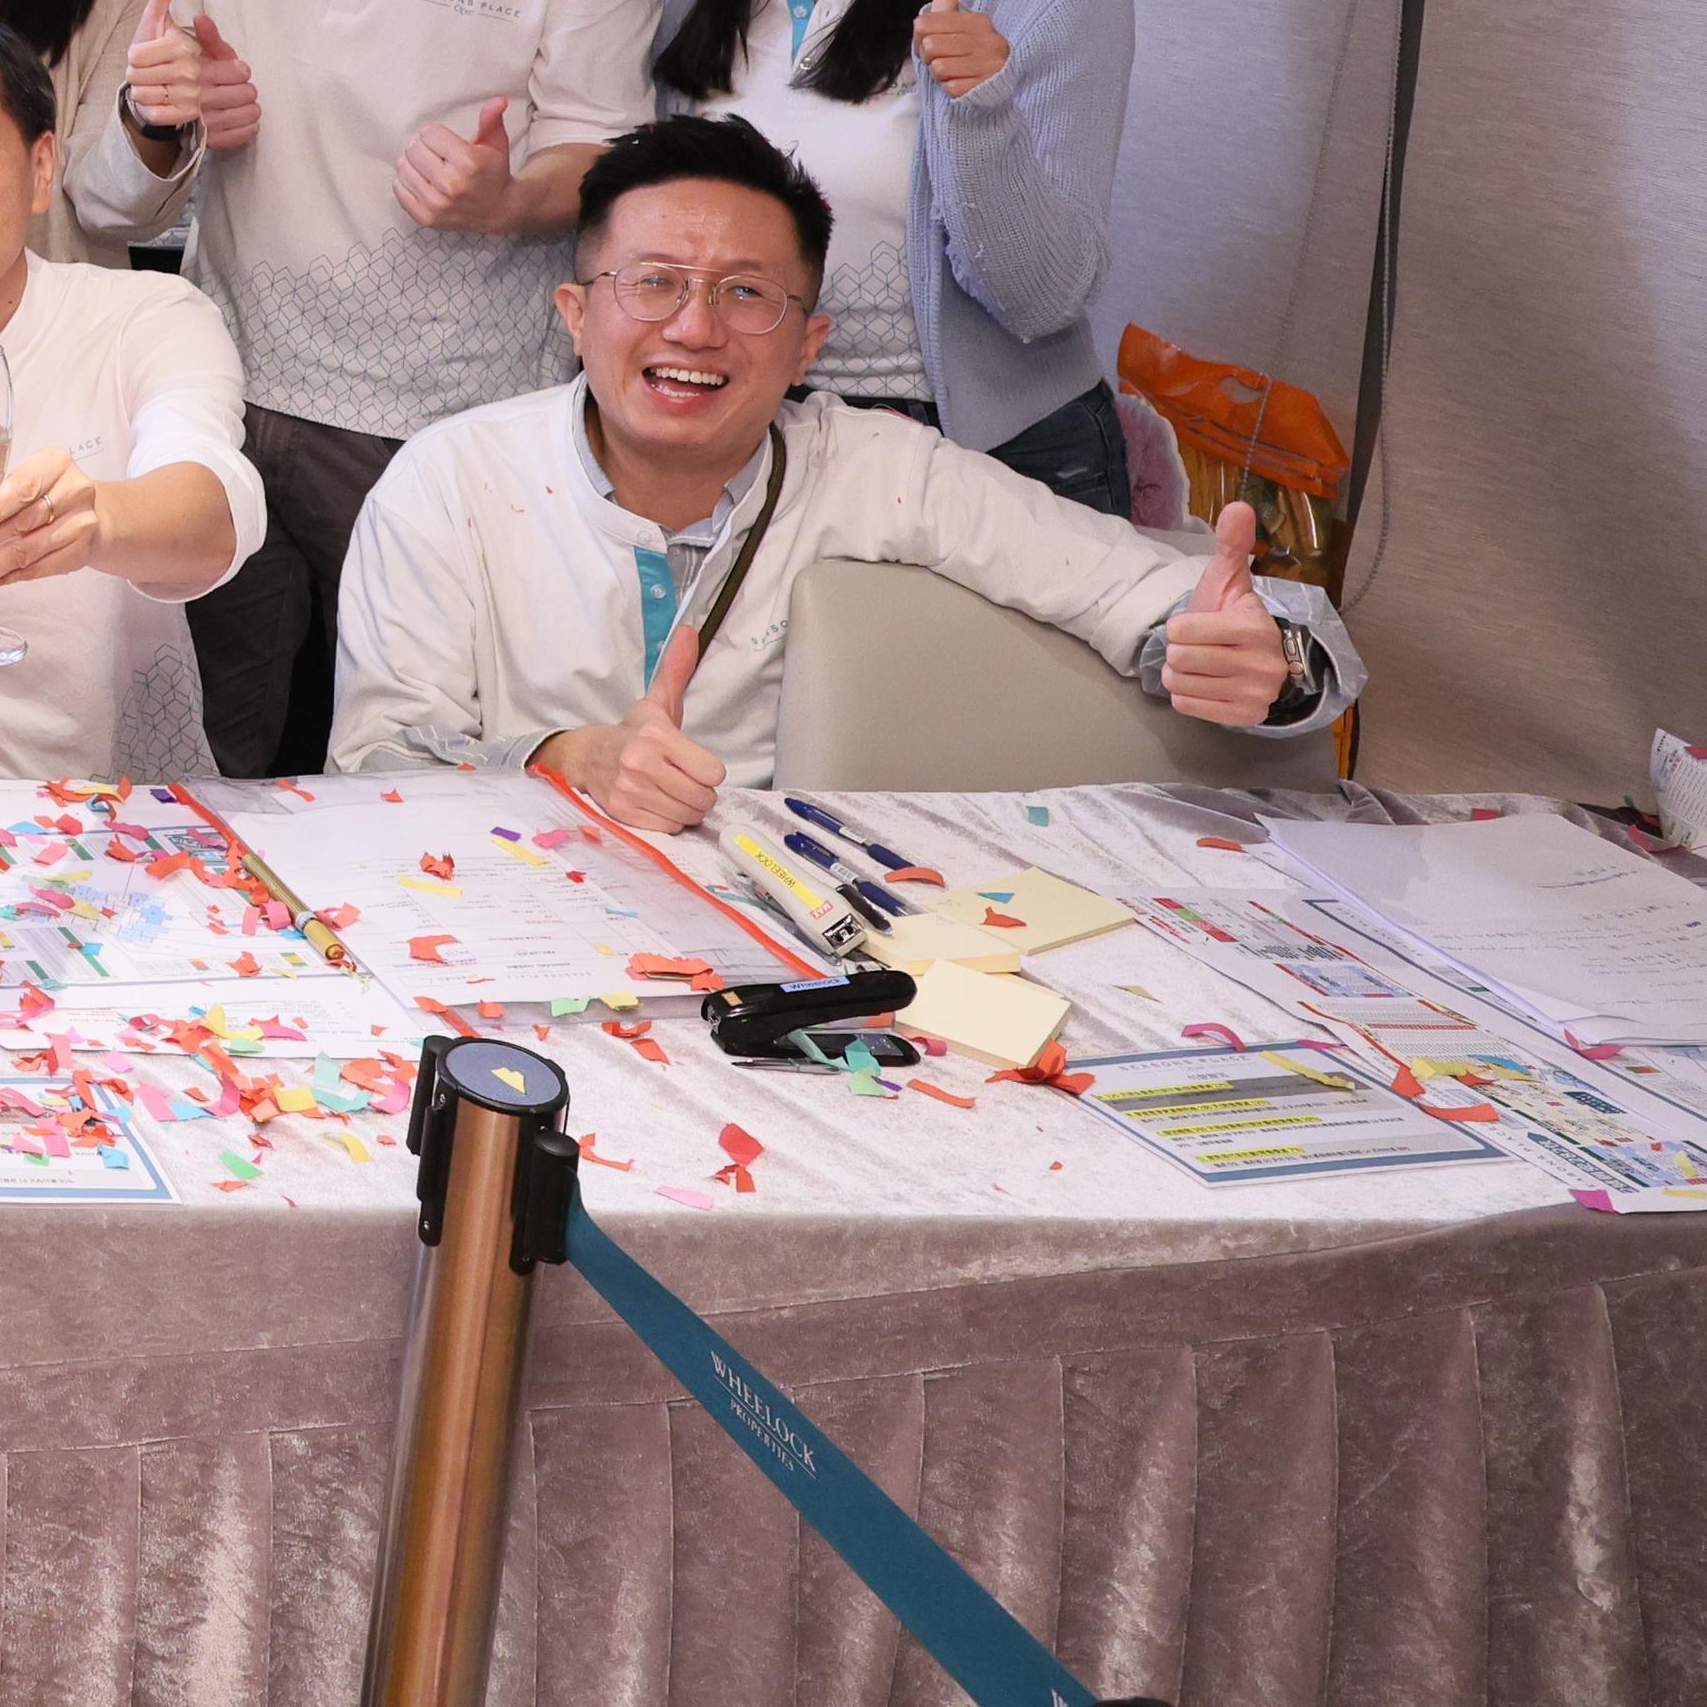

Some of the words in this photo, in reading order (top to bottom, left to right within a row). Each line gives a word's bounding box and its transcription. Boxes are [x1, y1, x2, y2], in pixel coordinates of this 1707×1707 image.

[481, 2, 521, 18] PLACE
[69, 436, 103, 454] LACE
[754, 851, 797, 890] WHEELOCK
[811, 902, 832, 919] MAX
[711, 1351, 817, 1472] WHEELOCK
[730, 1399, 795, 1471] PROPERTIES
